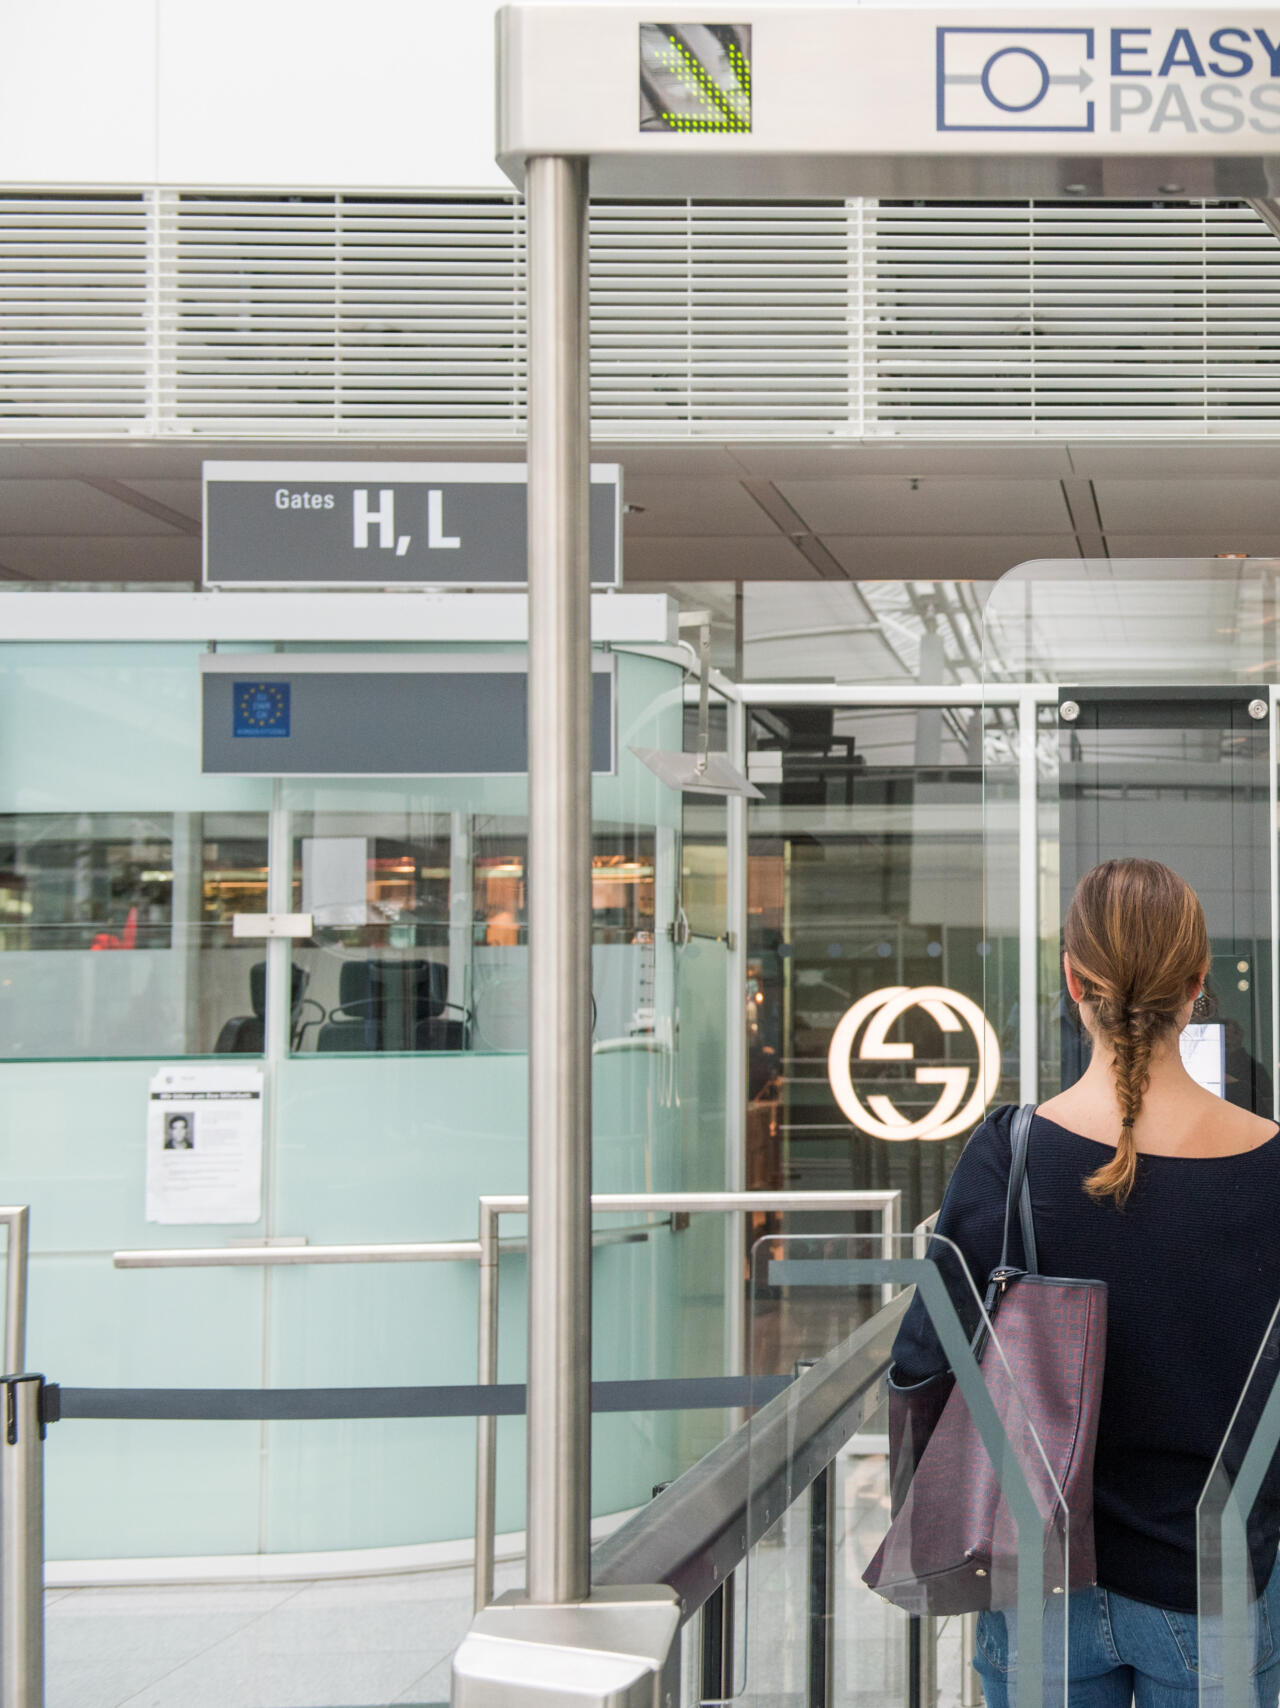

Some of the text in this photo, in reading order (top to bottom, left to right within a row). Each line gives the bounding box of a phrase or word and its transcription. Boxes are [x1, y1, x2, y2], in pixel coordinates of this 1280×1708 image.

[274, 488, 462, 556] Gates H, L
